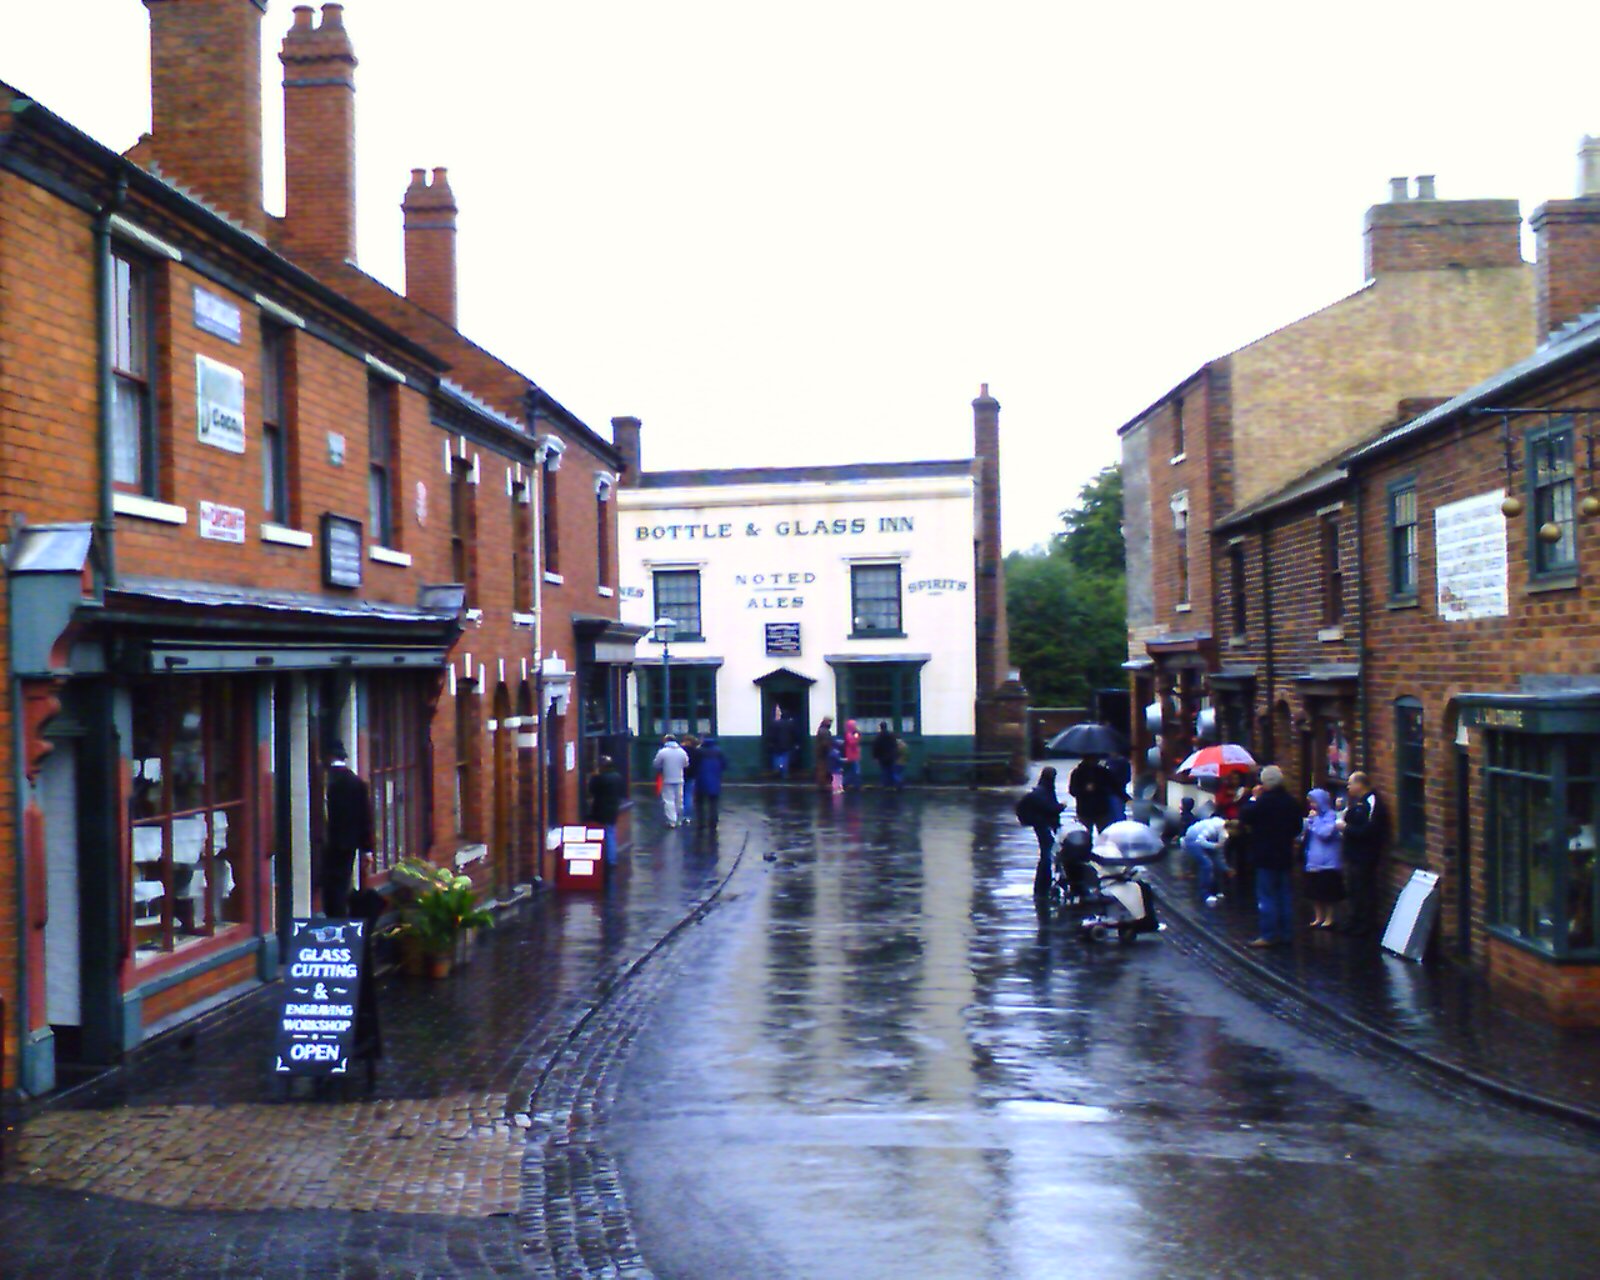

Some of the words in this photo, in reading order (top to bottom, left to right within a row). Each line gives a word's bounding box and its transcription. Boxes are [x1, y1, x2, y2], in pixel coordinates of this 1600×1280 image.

[636, 523, 732, 541] BOTTLE
[745, 522, 761, 537] &
[776, 518, 865, 536] GLASS
[879, 516, 914, 533] INN
[735, 572, 816, 585] NOTED
[908, 579, 968, 593] SPIRITS
[747, 596, 804, 609] ALES
[299, 948, 350, 962] GLASS
[291, 964, 357, 978] CUTTING
[313, 982, 329, 1000] &
[285, 1003, 353, 1016] ENGRAVING
[283, 1019, 352, 1032] WORKSHOP
[290, 1043, 340, 1060] OPEN
